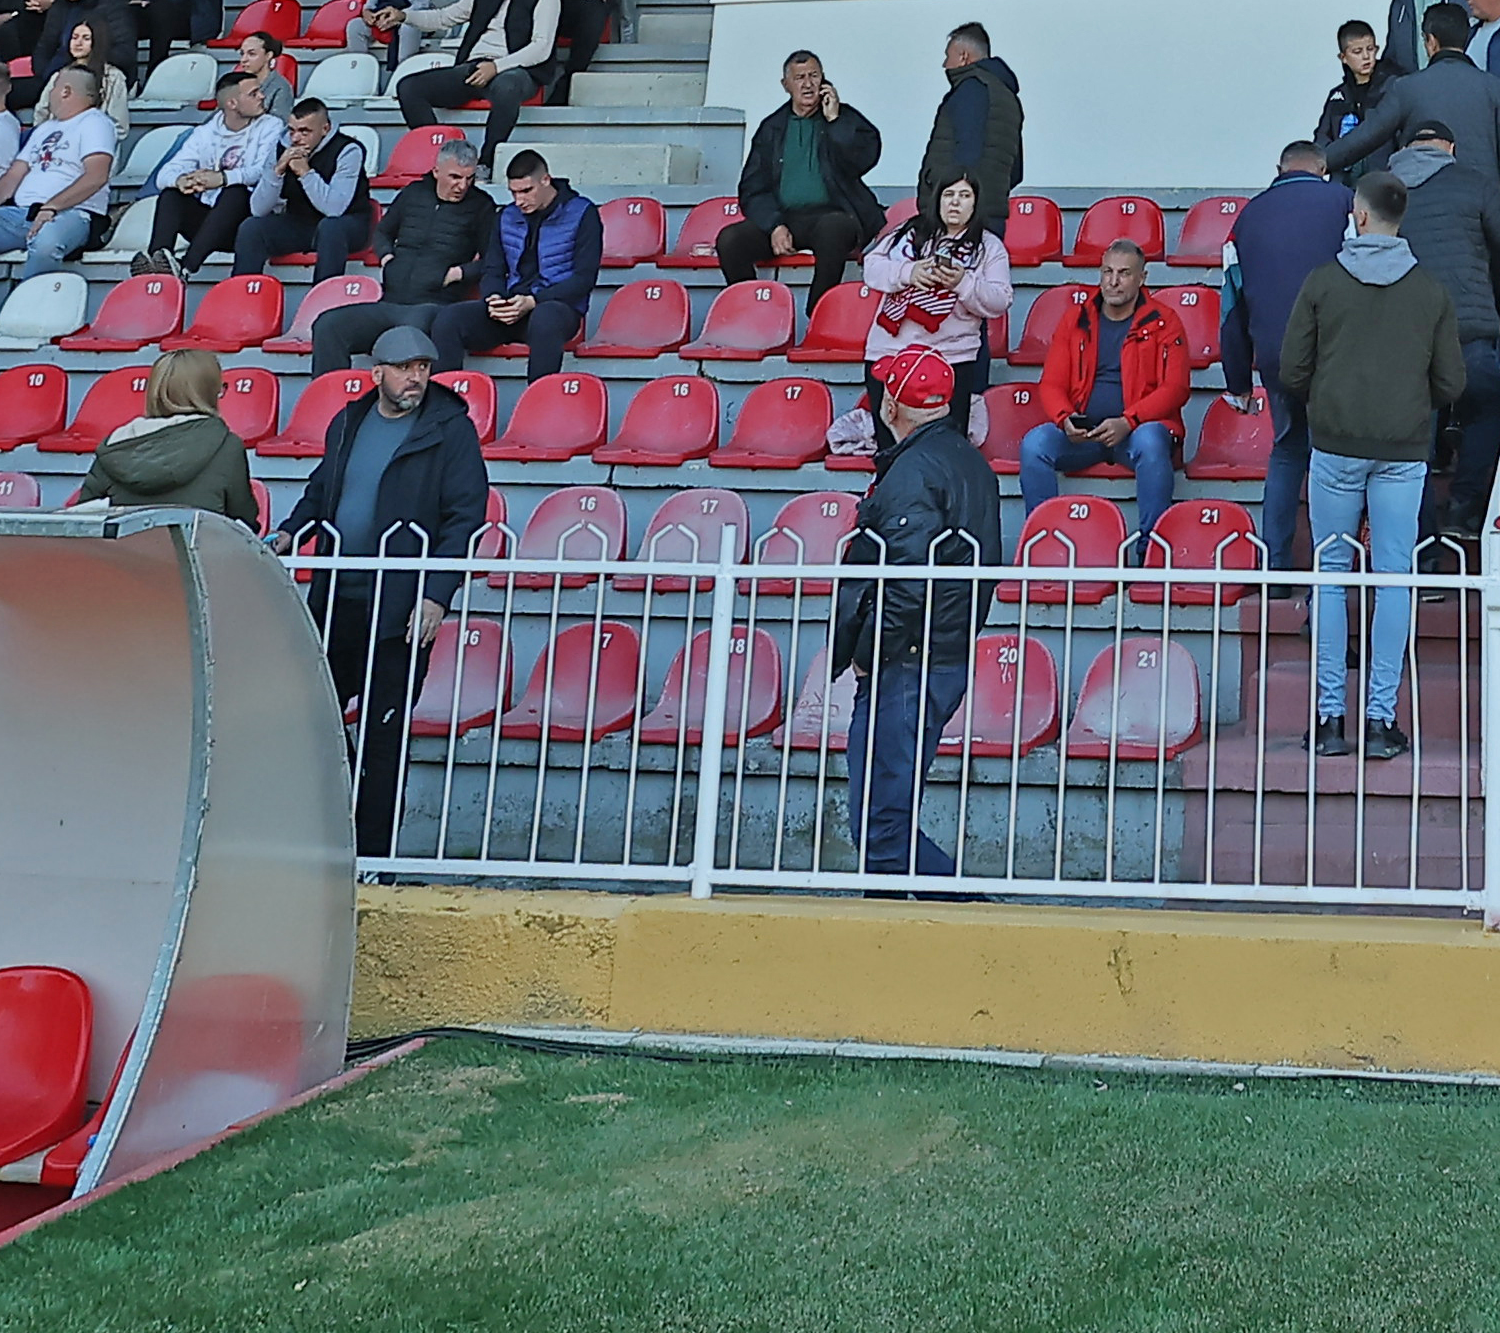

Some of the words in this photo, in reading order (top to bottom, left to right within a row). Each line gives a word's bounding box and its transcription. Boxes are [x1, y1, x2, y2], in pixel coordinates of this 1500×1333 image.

[273, 1, 281, 12] 7
[190, 61, 197, 70] 7
[350, 60, 358, 70] 9
[432, 134, 444, 145] 11
[628, 203, 641, 215] 14
[723, 203, 738, 215] 15
[1018, 202, 1032, 214] 18
[1121, 202, 1135, 214] 19
[1221, 202, 1236, 214] 20
[53, 281, 62, 293] 9
[147, 282, 162, 294] 10
[247, 281, 260, 293] 11
[346, 283, 360, 295] 12
[645, 287, 661, 299] 15
[756, 288, 771, 301] 16
[1072, 291, 1087, 304] 19
[1181, 292, 1197, 306] 20
[29, 373, 44, 386] 10
[133, 378, 146, 391] 11
[236, 379, 252, 393] 12
[345, 379, 361, 393] 13
[452, 380, 468, 393] 14
[563, 380, 579, 394] 15
[673, 383, 689, 396] 16
[785, 386, 802, 399] 17
[1013, 390, 1030, 404] 19
[579, 496, 597, 511] 16
[701, 498, 719, 514] 17
[820, 501, 838, 517] 18
[1069, 503, 1088, 519] 20
[1201, 508, 1218, 524] 21
[464, 629, 480, 646] 16
[729, 637, 746, 654] 18
[997, 646, 1018, 664] 20
[1137, 650, 1157, 668] 21
